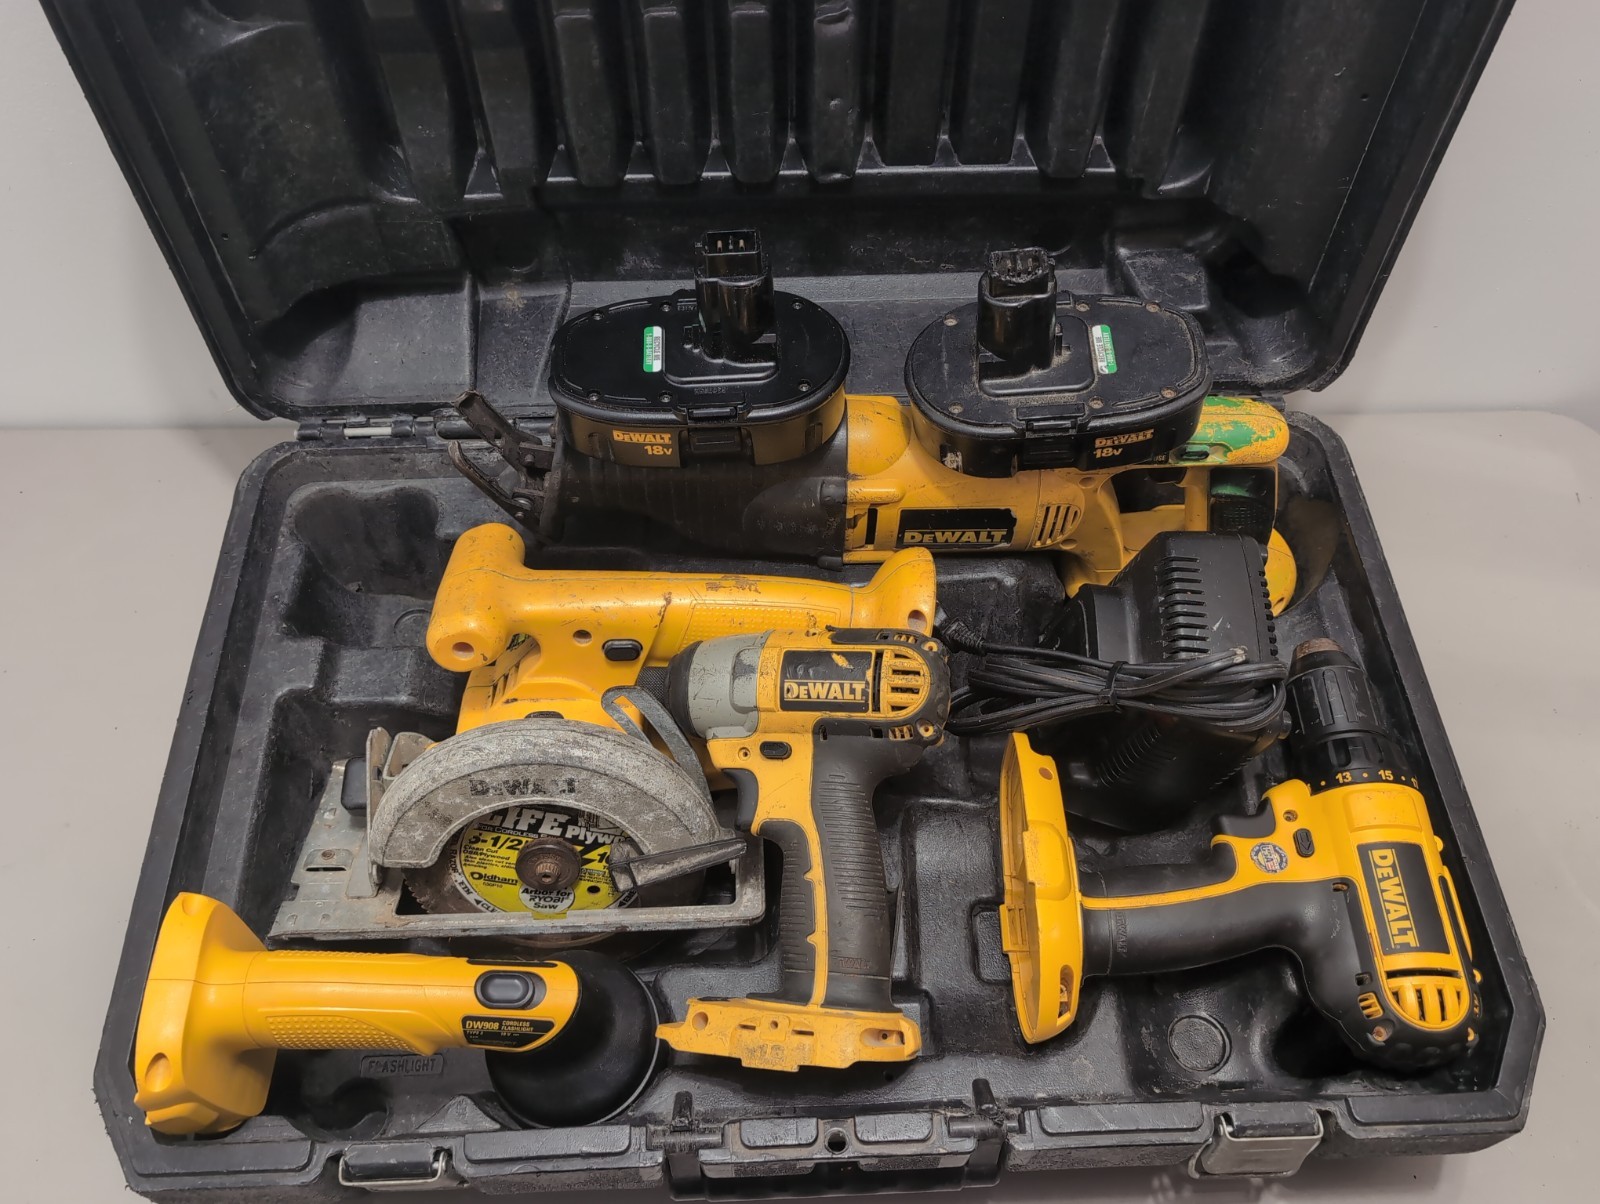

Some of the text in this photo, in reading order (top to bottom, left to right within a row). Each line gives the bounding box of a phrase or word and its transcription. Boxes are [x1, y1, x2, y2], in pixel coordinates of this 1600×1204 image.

[1336, 771, 1352, 784] 13
[1378, 769, 1394, 781] 15
[469, 778, 577, 796] DEWAT
[463, 844, 484, 852] Clean
[470, 871, 519, 885] Oldham
[521, 888, 573, 897] Arbor for
[529, 894, 565, 904] RYOBI
[533, 902, 559, 910] Saw
[465, 1020, 500, 1030] DW908
